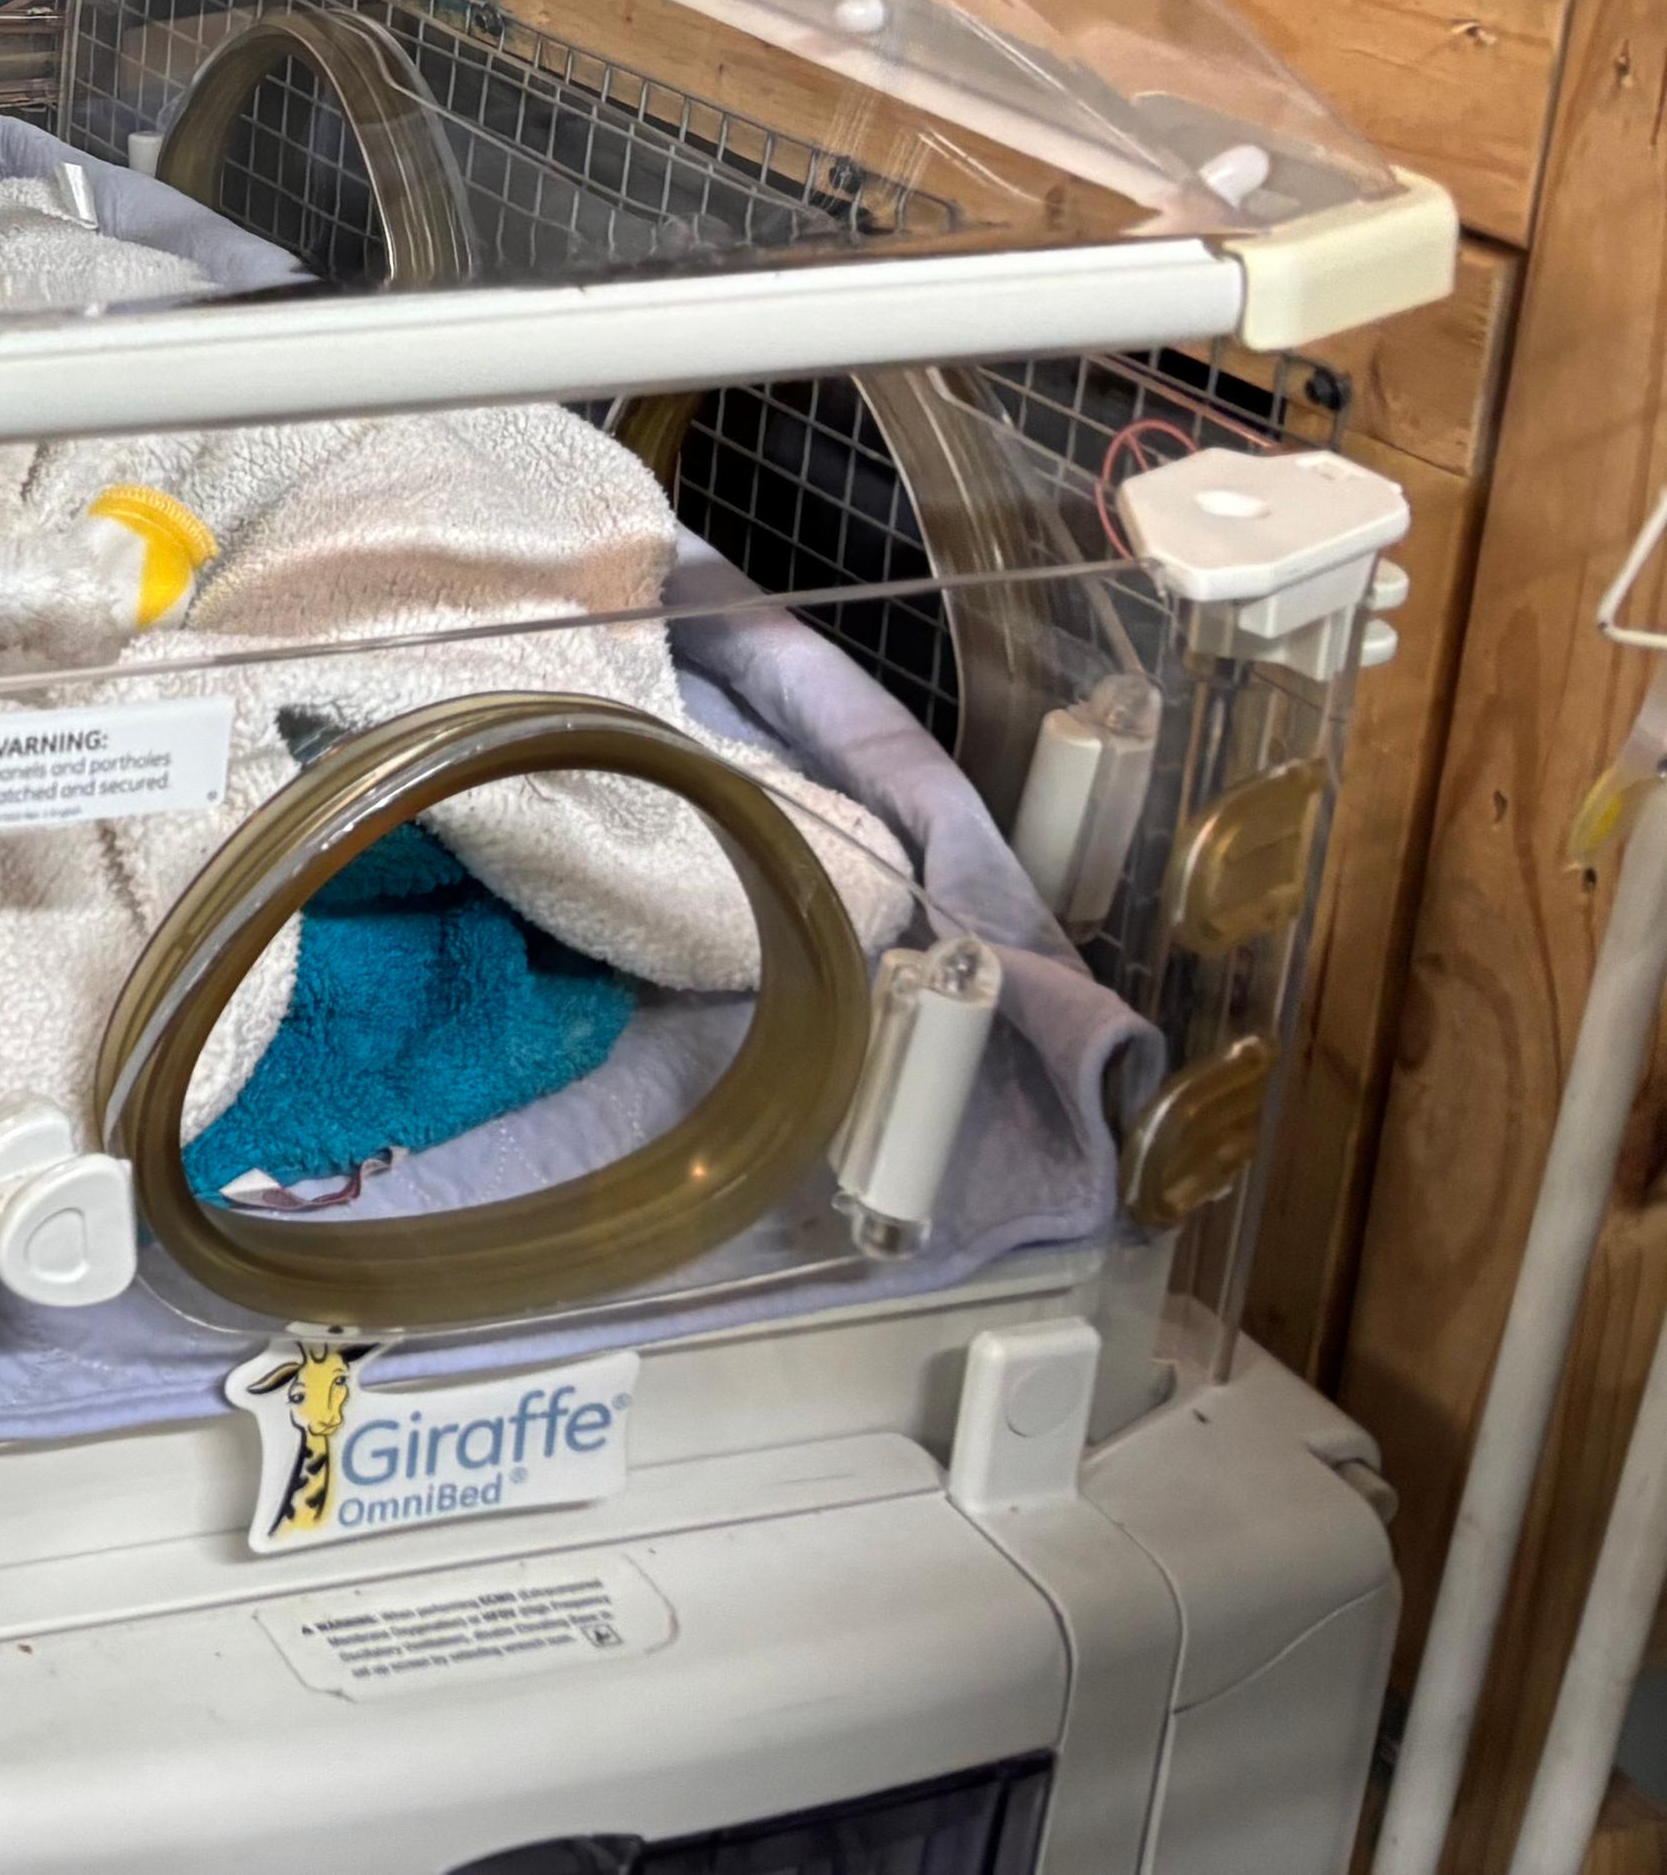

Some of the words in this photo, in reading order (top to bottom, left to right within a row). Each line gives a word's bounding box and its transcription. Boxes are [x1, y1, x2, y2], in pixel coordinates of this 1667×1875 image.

[50, 757, 86, 777] and
[89, 751, 171, 776] portholes
[60, 780, 96, 798] and
